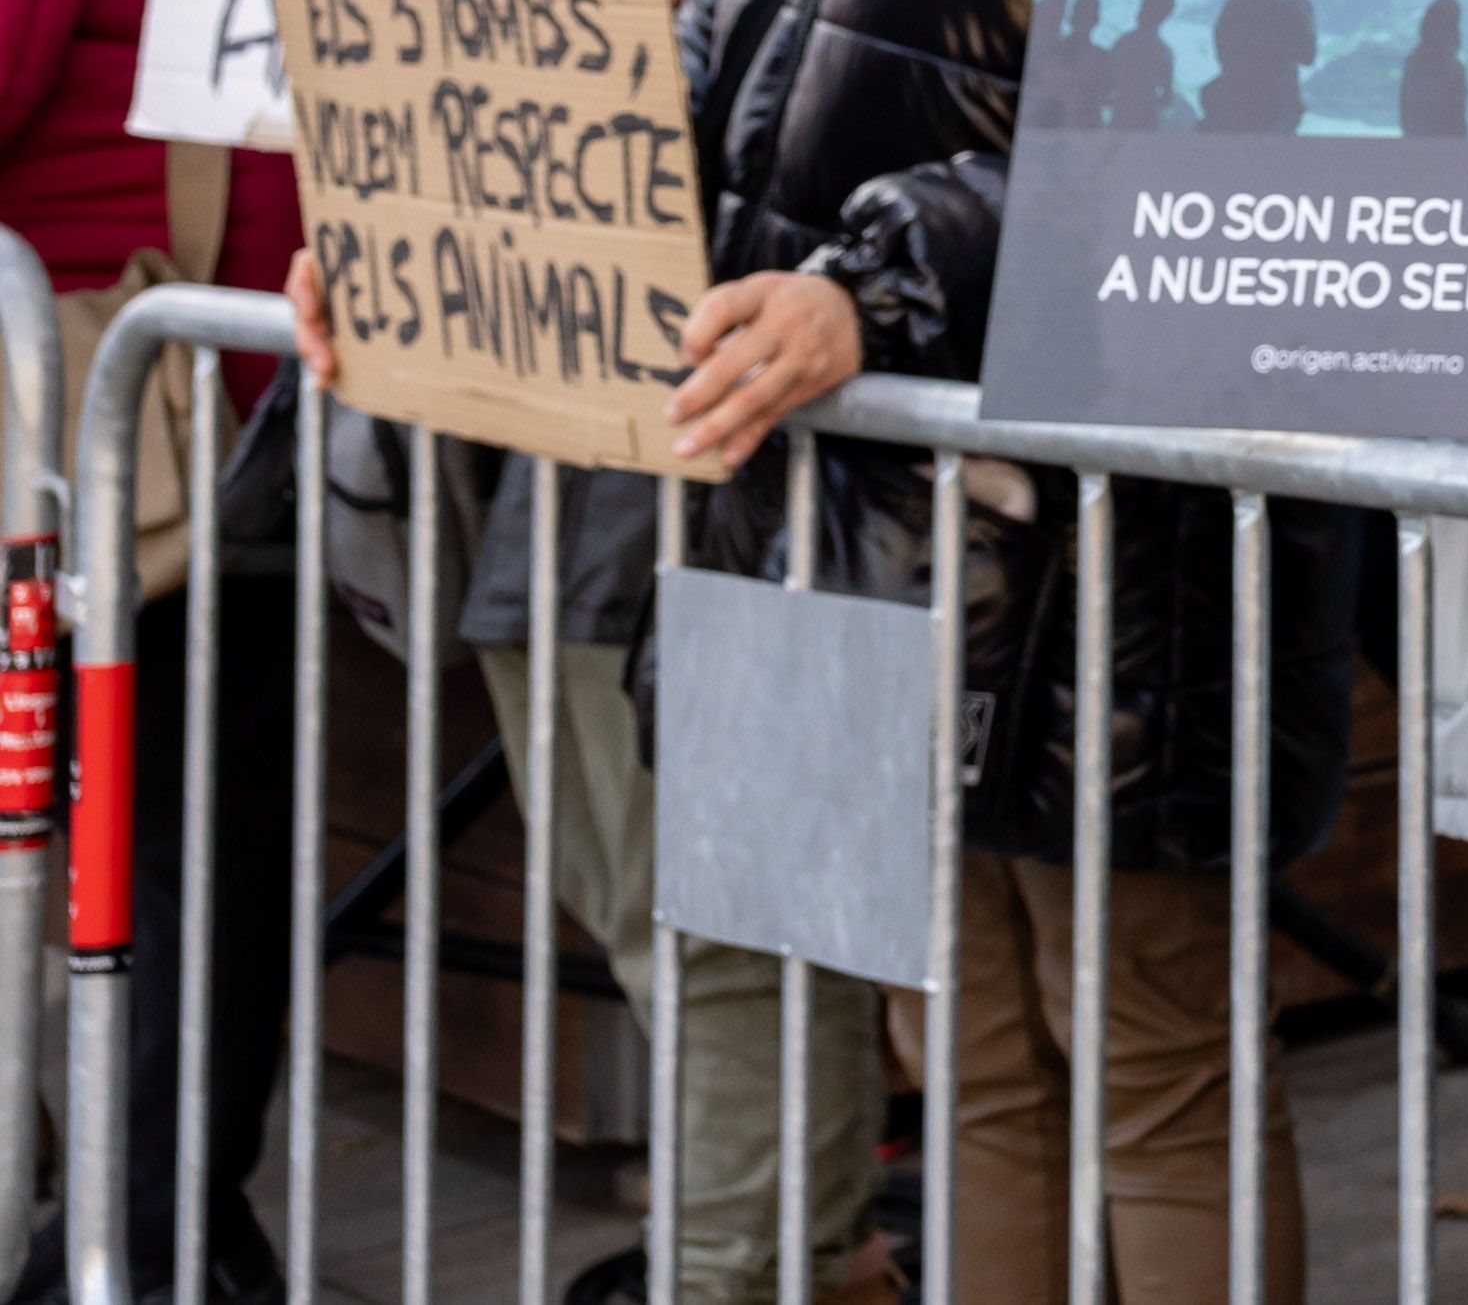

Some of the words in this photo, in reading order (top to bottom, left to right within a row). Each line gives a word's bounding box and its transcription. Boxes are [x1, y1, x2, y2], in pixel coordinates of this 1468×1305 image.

[432, 80, 683, 228] RESPECTE
[1133, 191, 1215, 241] NO
[1221, 193, 1334, 243] SON
[1098, 254, 1139, 302] A
[1148, 254, 1393, 309] NUESTRO
